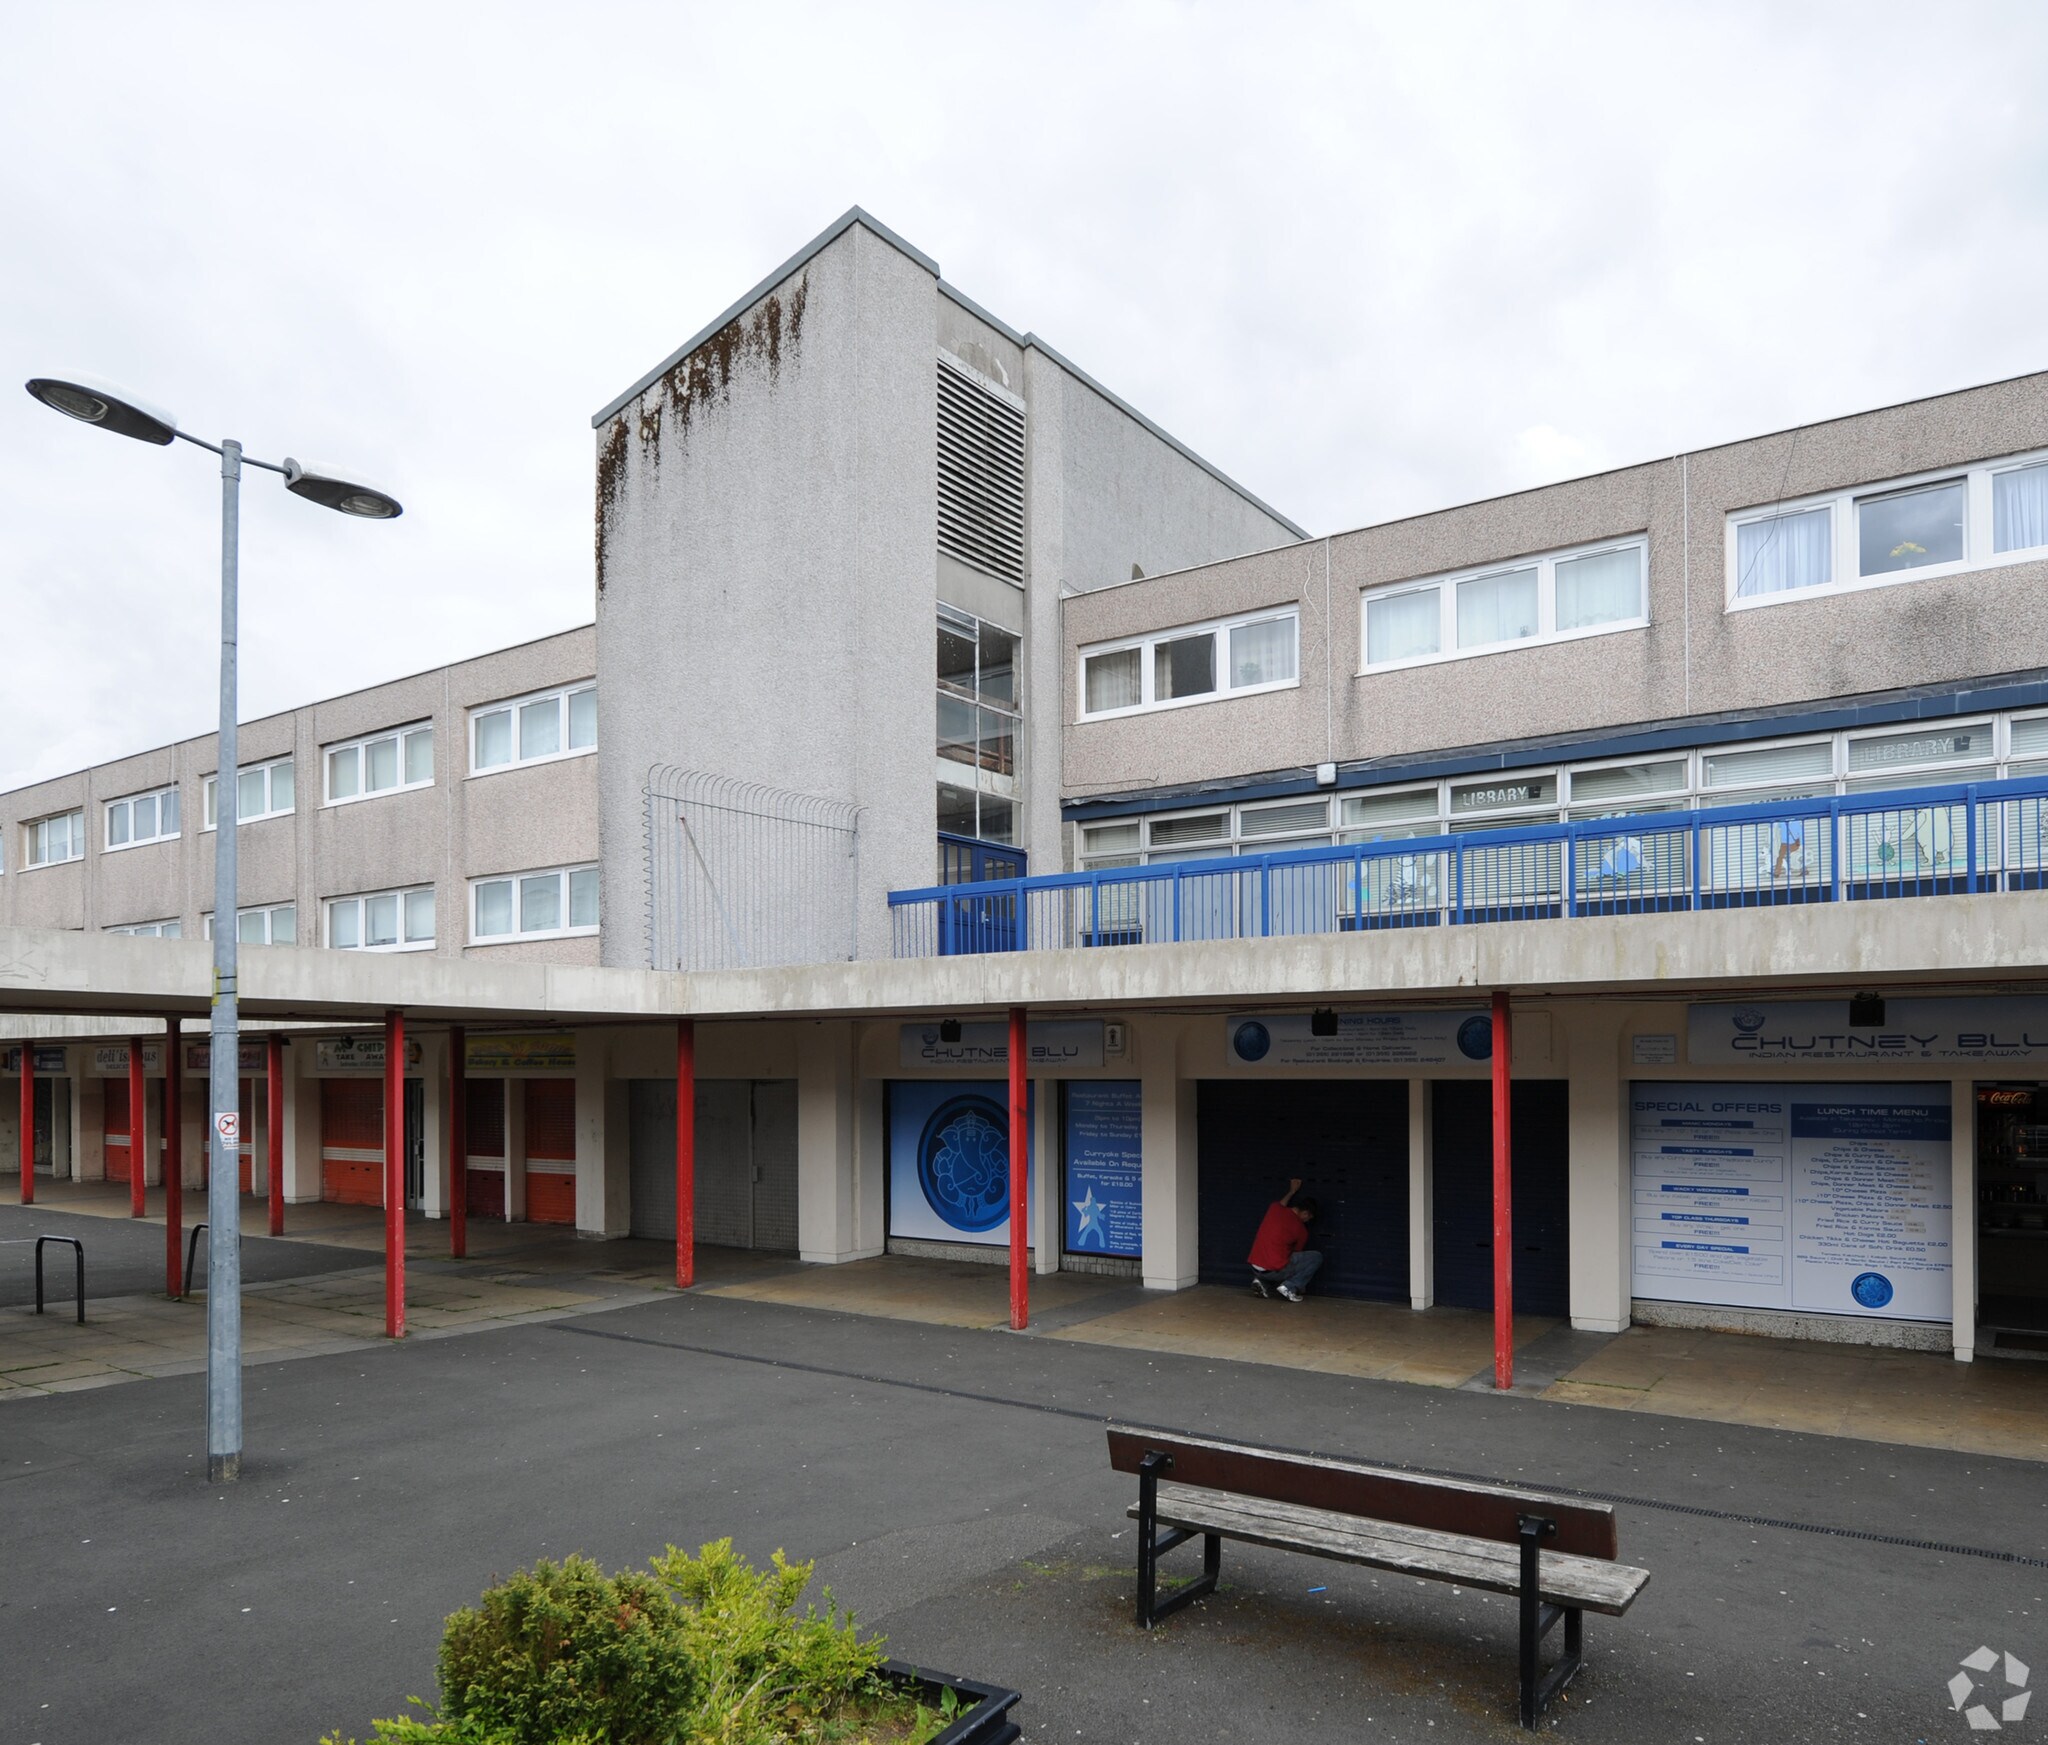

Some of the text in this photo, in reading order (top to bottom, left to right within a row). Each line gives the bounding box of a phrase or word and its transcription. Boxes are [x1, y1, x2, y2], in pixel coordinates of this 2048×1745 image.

[1863, 737, 1951, 762] LIBRARY
[1462, 785, 1527, 806] LIBRARY
[1731, 1033, 1938, 1050] CHUTNEY
[921, 1046, 1079, 1058] CHUTNE BLU
[1748, 1051, 1797, 1059] INDIAN
[1801, 1051, 1915, 1059] RESTAURANT
[1941, 1050, 2033, 1058] TAKEAWAY
[1634, 1101, 1783, 1114] SPECIAL OFFERS
[1816, 1108, 1930, 1118] LUNCH TIME MENU
[1073, 1158, 1107, 1167] Available
[1121, 1160, 1142, 1169] Requ
